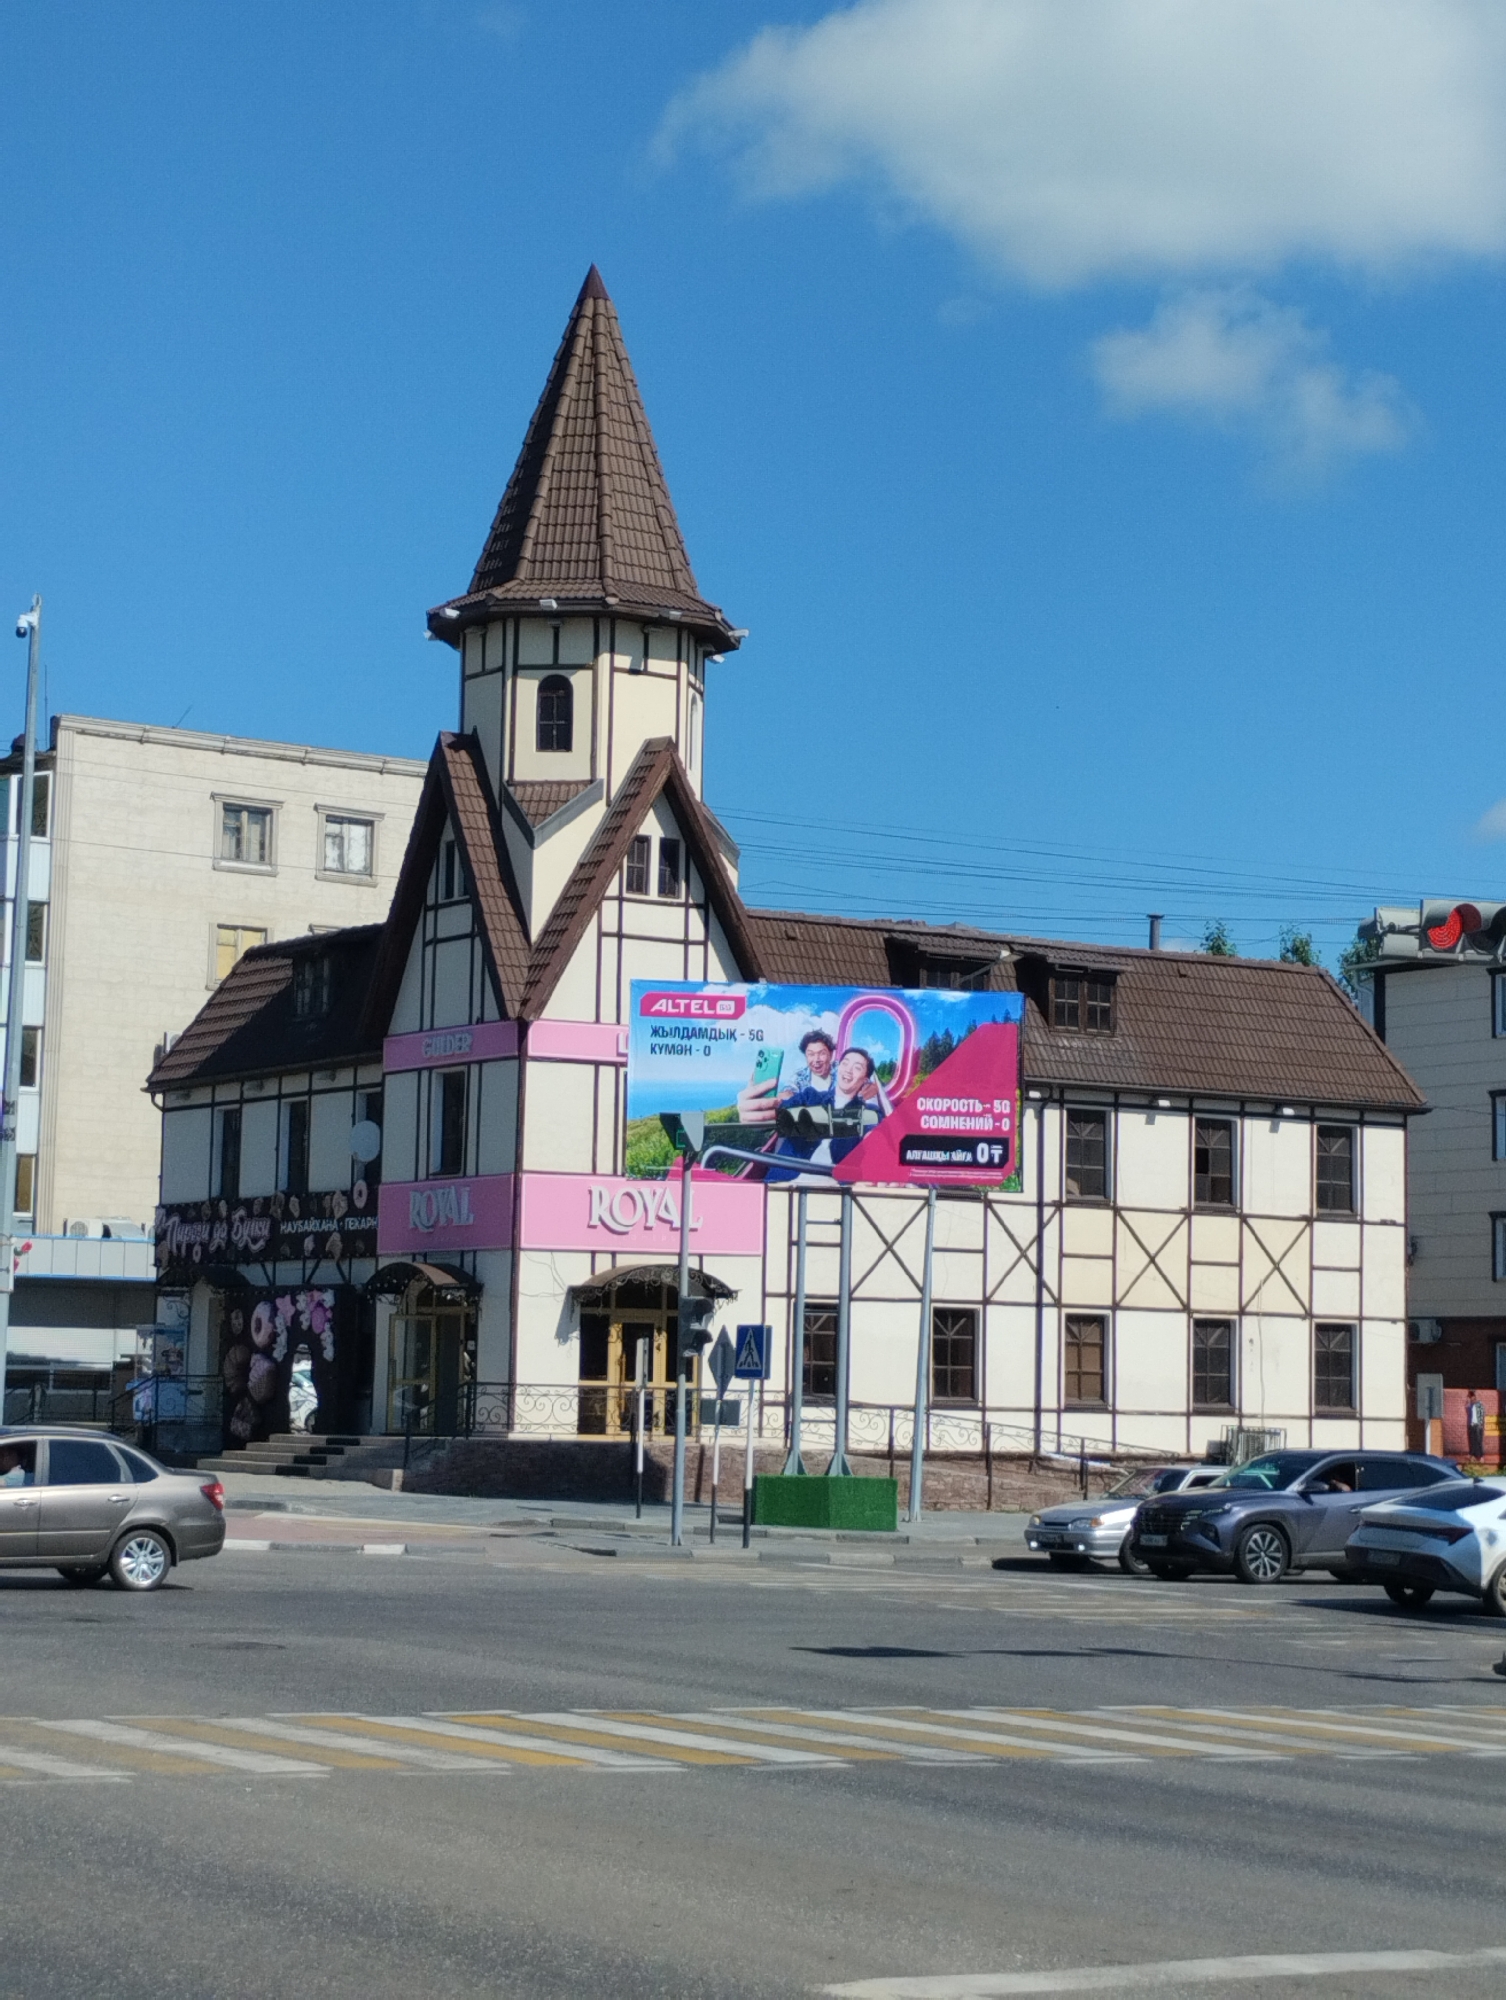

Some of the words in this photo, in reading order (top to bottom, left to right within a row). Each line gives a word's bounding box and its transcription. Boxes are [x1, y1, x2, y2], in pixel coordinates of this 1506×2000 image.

[650, 998, 715, 1014] ALTEL
[650, 1025, 737, 1042] ЖЫЛДАМДЫҚ
[748, 1029, 764, 1042] 5G
[650, 1043, 692, 1056] КҮМӘН
[917, 1097, 983, 1113] СКОРОСТЬ
[993, 1099, 1010, 1114] 5G
[920, 1113, 993, 1131] СОМНЕНИЙ
[410, 1185, 474, 1233] ROYAL
